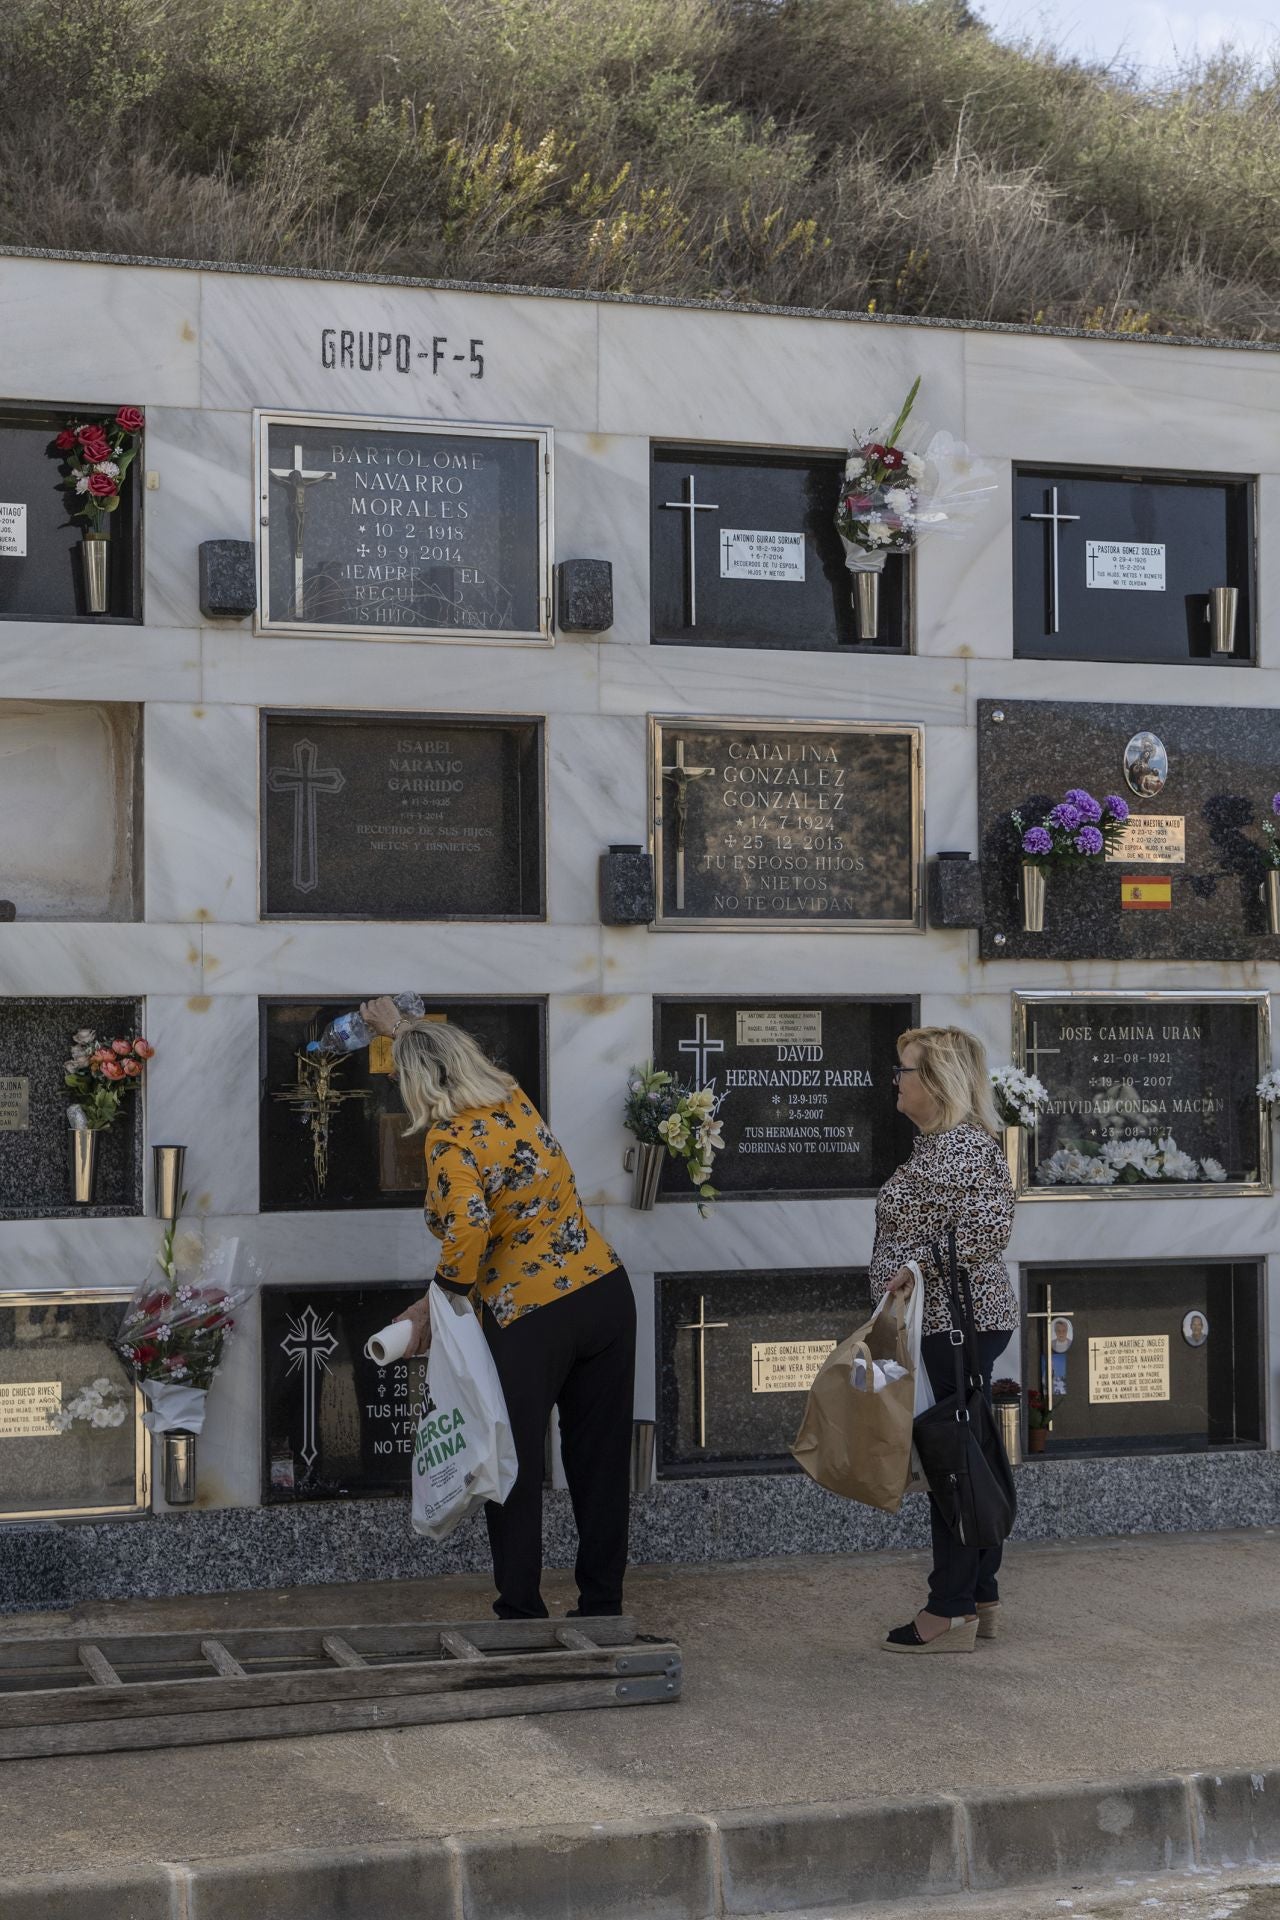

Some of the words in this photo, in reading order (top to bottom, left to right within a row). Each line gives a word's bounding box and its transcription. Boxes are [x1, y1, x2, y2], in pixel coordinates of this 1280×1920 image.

[331, 445, 484, 470] BARTOLOME
[355, 472, 463, 494] NAVARRO
[351, 497, 468, 519] MORALES
[733, 533, 755, 543] ANTONIO
[757, 534, 776, 544] GUIRAO
[778, 535, 801, 545] SORIANO
[1097, 545, 1120, 554] PASTORA
[1141, 547, 1161, 556] SOLERA
[341, 564, 421, 581] IEMPRE
[461, 569, 485, 584] EL
[397, 740, 453, 753] ISABEL
[728, 742, 838, 762] CATALINA
[389, 758, 463, 775] NARANJO
[723, 766, 845, 787] GONZALEZ
[388, 778, 464, 792] GARRIDO
[723, 790, 844, 810] GONZALEZ
[357, 825, 415, 835] RECUERDO
[419, 826, 434, 836] DE
[439, 827, 459, 837] SUS
[370, 841, 408, 851] NIETOS
[703, 855, 726, 869] TU
[734, 856, 808, 870] ESPOSO
[816, 856, 865, 871] HIJOS
[743, 876, 752, 890] Y
[760, 876, 827, 891] NIETOS
[714, 895, 739, 911] NO
[746, 896, 766, 911] TE
[772, 896, 854, 912] OLVIDAN
[1059, 1026, 1092, 1041] JOSE
[777, 1045, 824, 1062] DAVID
[1103, 1053, 1171, 1064] 21-08-1921
[725, 1069, 821, 1087] HERNANDEZ
[824, 1070, 874, 1087] PARRA
[788, 1094, 828, 1105] 12-9-1975
[1036, 1099, 1110, 1114] NATIVIDAD
[1115, 1099, 1167, 1113] CONESA
[788, 1109, 824, 1120] 2-5-2007
[744, 1126, 764, 1138] TUS
[766, 1126, 822, 1139] HERMANOS,
[824, 1126, 845, 1138] TIOS
[847, 1126, 854, 1138] Y
[738, 1142, 786, 1154] SOBRINAS
[788, 1142, 803, 1154] NO
[804, 1142, 816, 1153] TE
[817, 1142, 860, 1153] OLVIDAN
[1118, 1355, 1138, 1364] ORTEGA
[1140, 1354, 1164, 1363] NAVARRO
[789, 1363, 803, 1372] VERA
[806, 1362, 823, 1372] BUEN
[12, 1387, 35, 1397] CHUECO
[38, 1386, 54, 1396] RIVES
[366, 1404, 391, 1418] TUS
[391, 1422, 399, 1435] Y
[374, 1441, 393, 1454] NO
[395, 1440, 411, 1453] TE
[417, 1432, 466, 1476] CHINA
